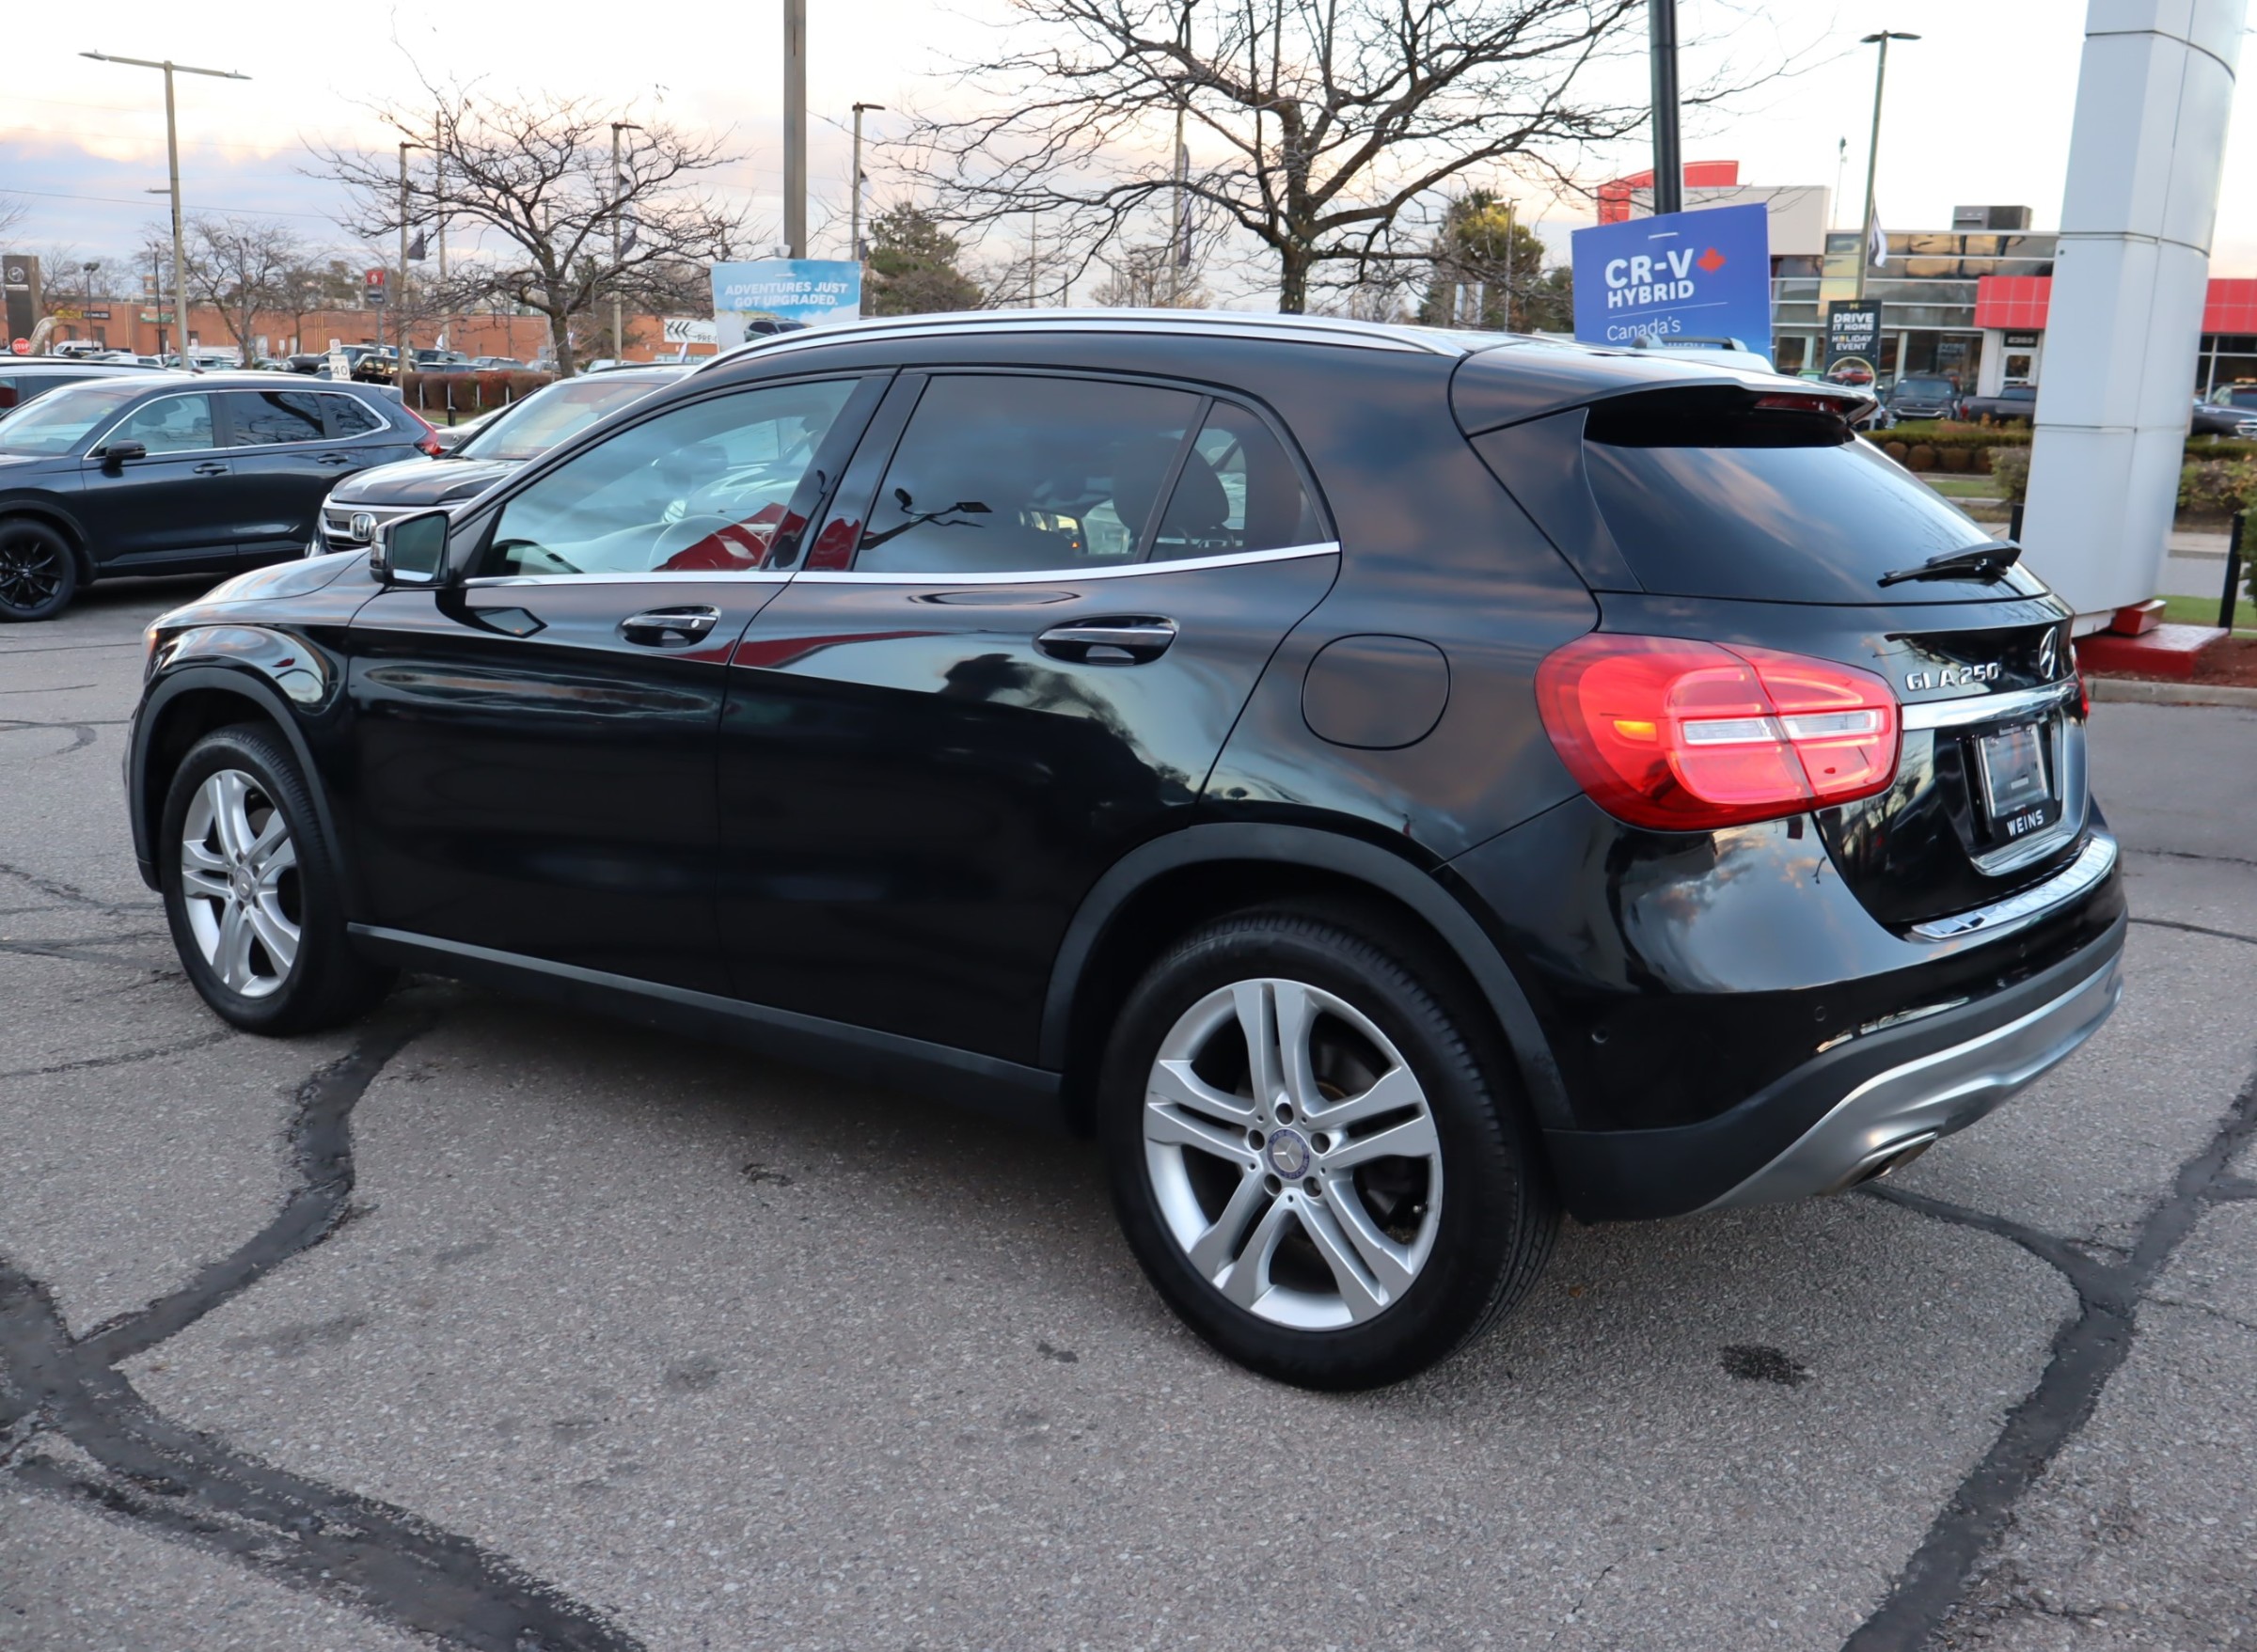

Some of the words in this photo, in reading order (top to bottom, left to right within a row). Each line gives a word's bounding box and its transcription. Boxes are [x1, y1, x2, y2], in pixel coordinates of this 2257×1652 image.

[1604, 248, 1695, 289] CR-V
[725, 282, 812, 295] ADVENTURES
[814, 281, 848, 293] JUST
[1607, 279, 1695, 309] HYBRID
[734, 296, 759, 307] GOT
[764, 294, 839, 307] UPGRADED.
[1833, 312, 1874, 323] DRIVE
[1606, 316, 1681, 341] Canada's
[1831, 335, 1872, 343] HOLIDAY
[14, 342, 31, 351] STOP
[332, 366, 347, 375] 40
[2007, 810, 2044, 836] WEINS
